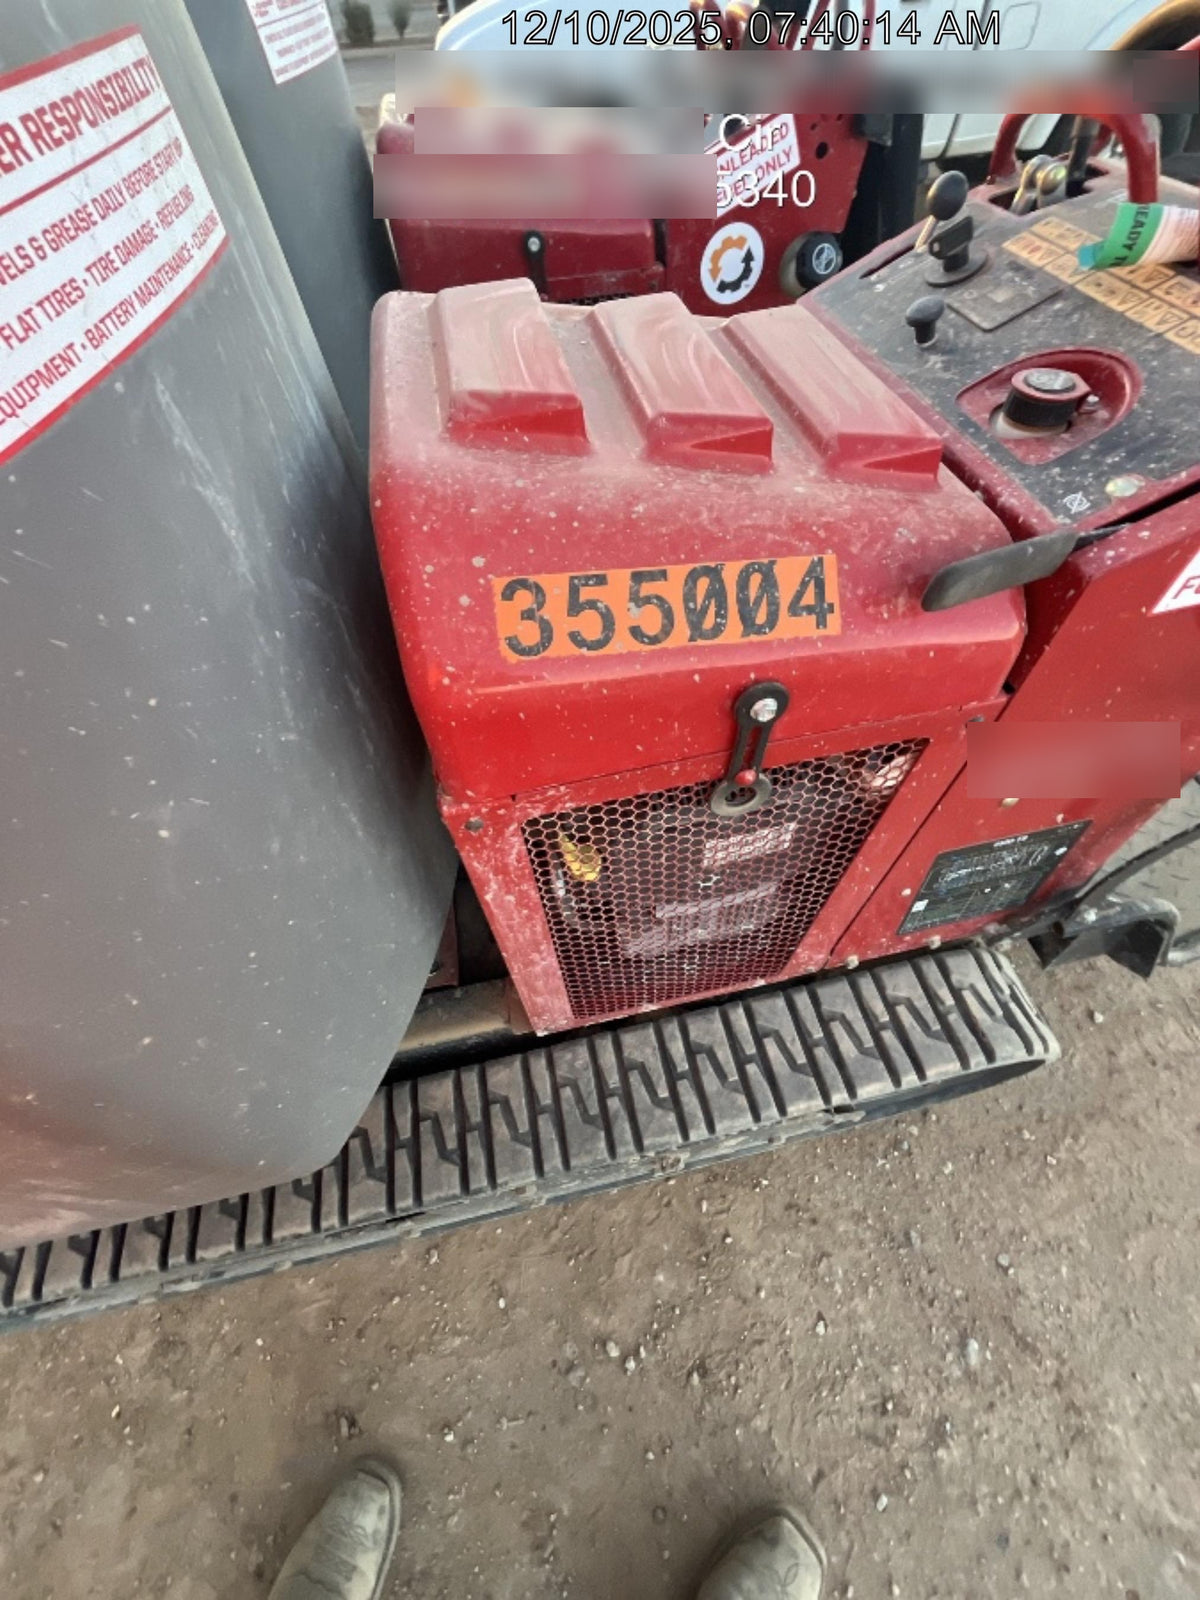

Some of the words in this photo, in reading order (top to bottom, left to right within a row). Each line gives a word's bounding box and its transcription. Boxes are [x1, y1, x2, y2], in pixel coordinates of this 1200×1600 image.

[18, 54, 161, 157] RESPONSIBILITY
[718, 121, 790, 177] NLEADED
[27, 236, 47, 261] &
[41, 204, 98, 253] GREASE
[91, 181, 127, 220] DAILY
[121, 160, 159, 199] BEFORE
[754, 145, 793, 181] ONLY
[0, 307, 42, 350] FLAT
[35, 277, 86, 322] TIRES
[84, 251, 121, 286] TIRE
[113, 219, 159, 266] DAMAGE
[84, 295, 138, 350] BATTERY
[133, 242, 195, 309] MAINTENANCE
[500, 555, 835, 657] 355004
